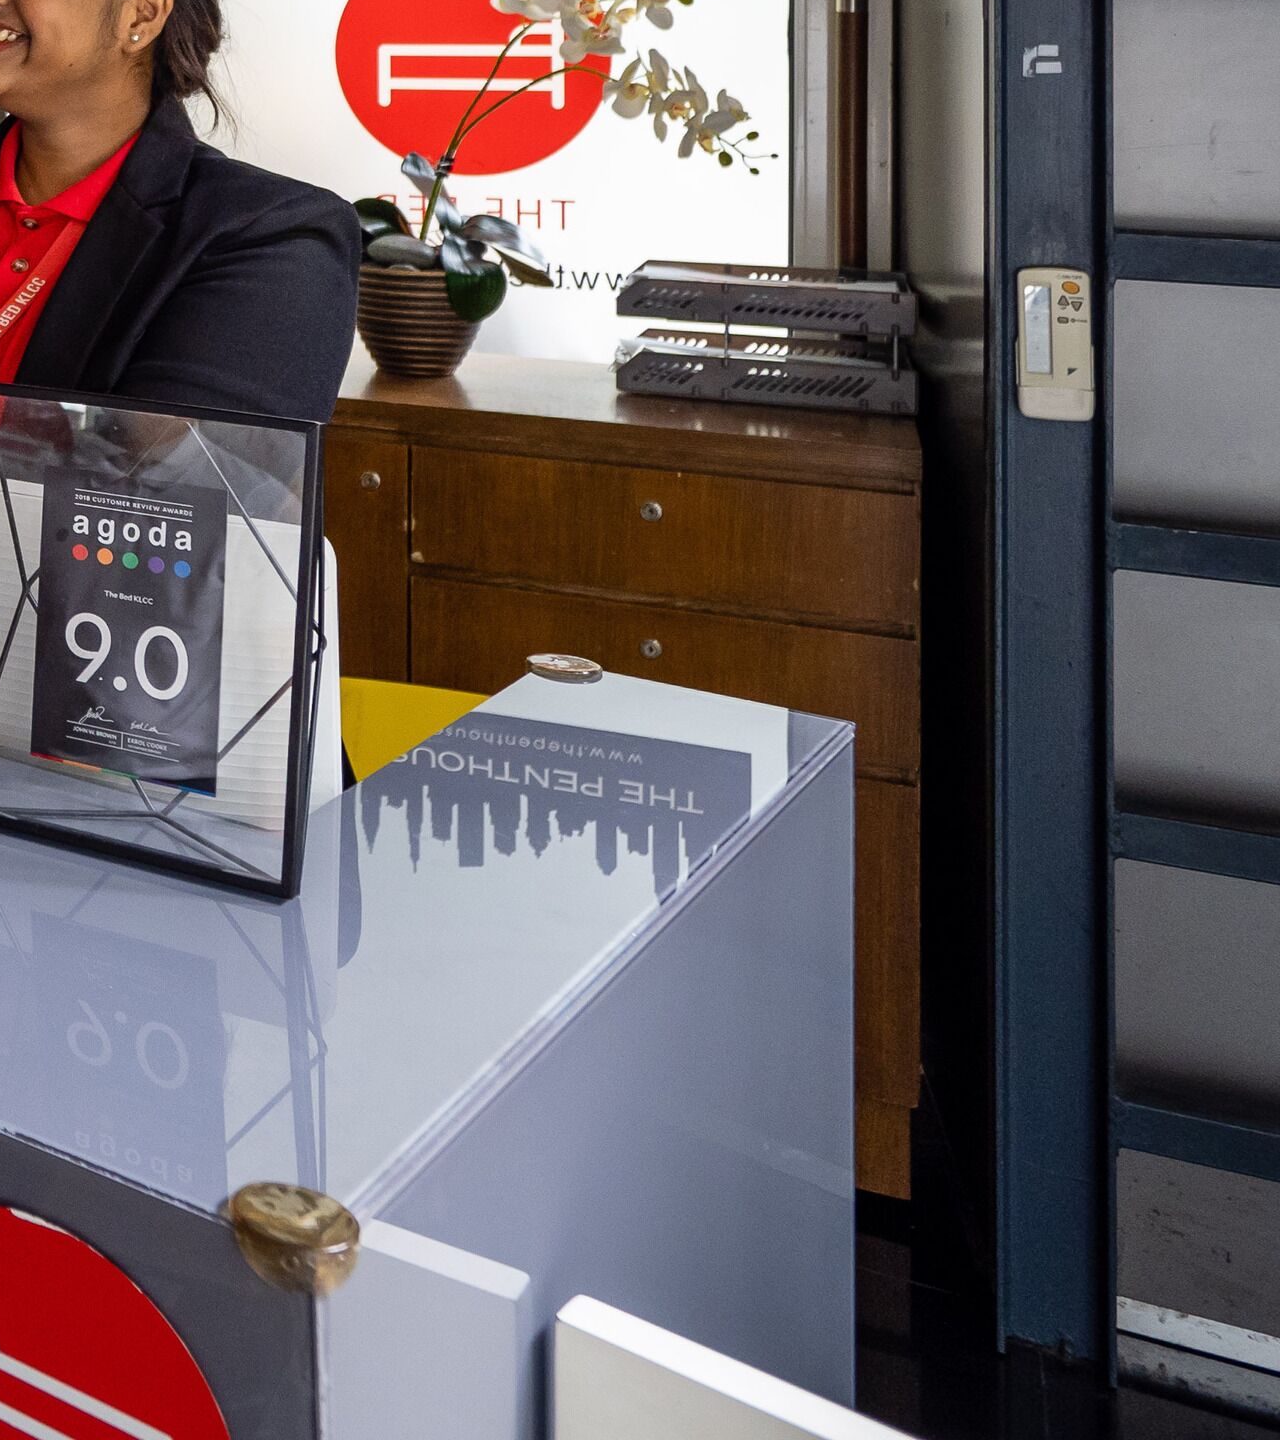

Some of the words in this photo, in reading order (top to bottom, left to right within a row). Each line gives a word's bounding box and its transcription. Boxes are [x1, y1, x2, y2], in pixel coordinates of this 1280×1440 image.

[15, 276, 46, 306] KLCC
[91, 495, 131, 508] CUSTOMER
[132, 502, 161, 513] REVIEW
[161, 507, 194, 518] AWARDS
[72, 513, 193, 552] agoda
[104, 588, 118, 600] The
[118, 591, 132, 603] Bed
[133, 593, 154, 606] KLCC
[64, 611, 189, 701] 9.0
[391, 744, 604, 799] PENTHOU
[618, 778, 704, 816] THE
